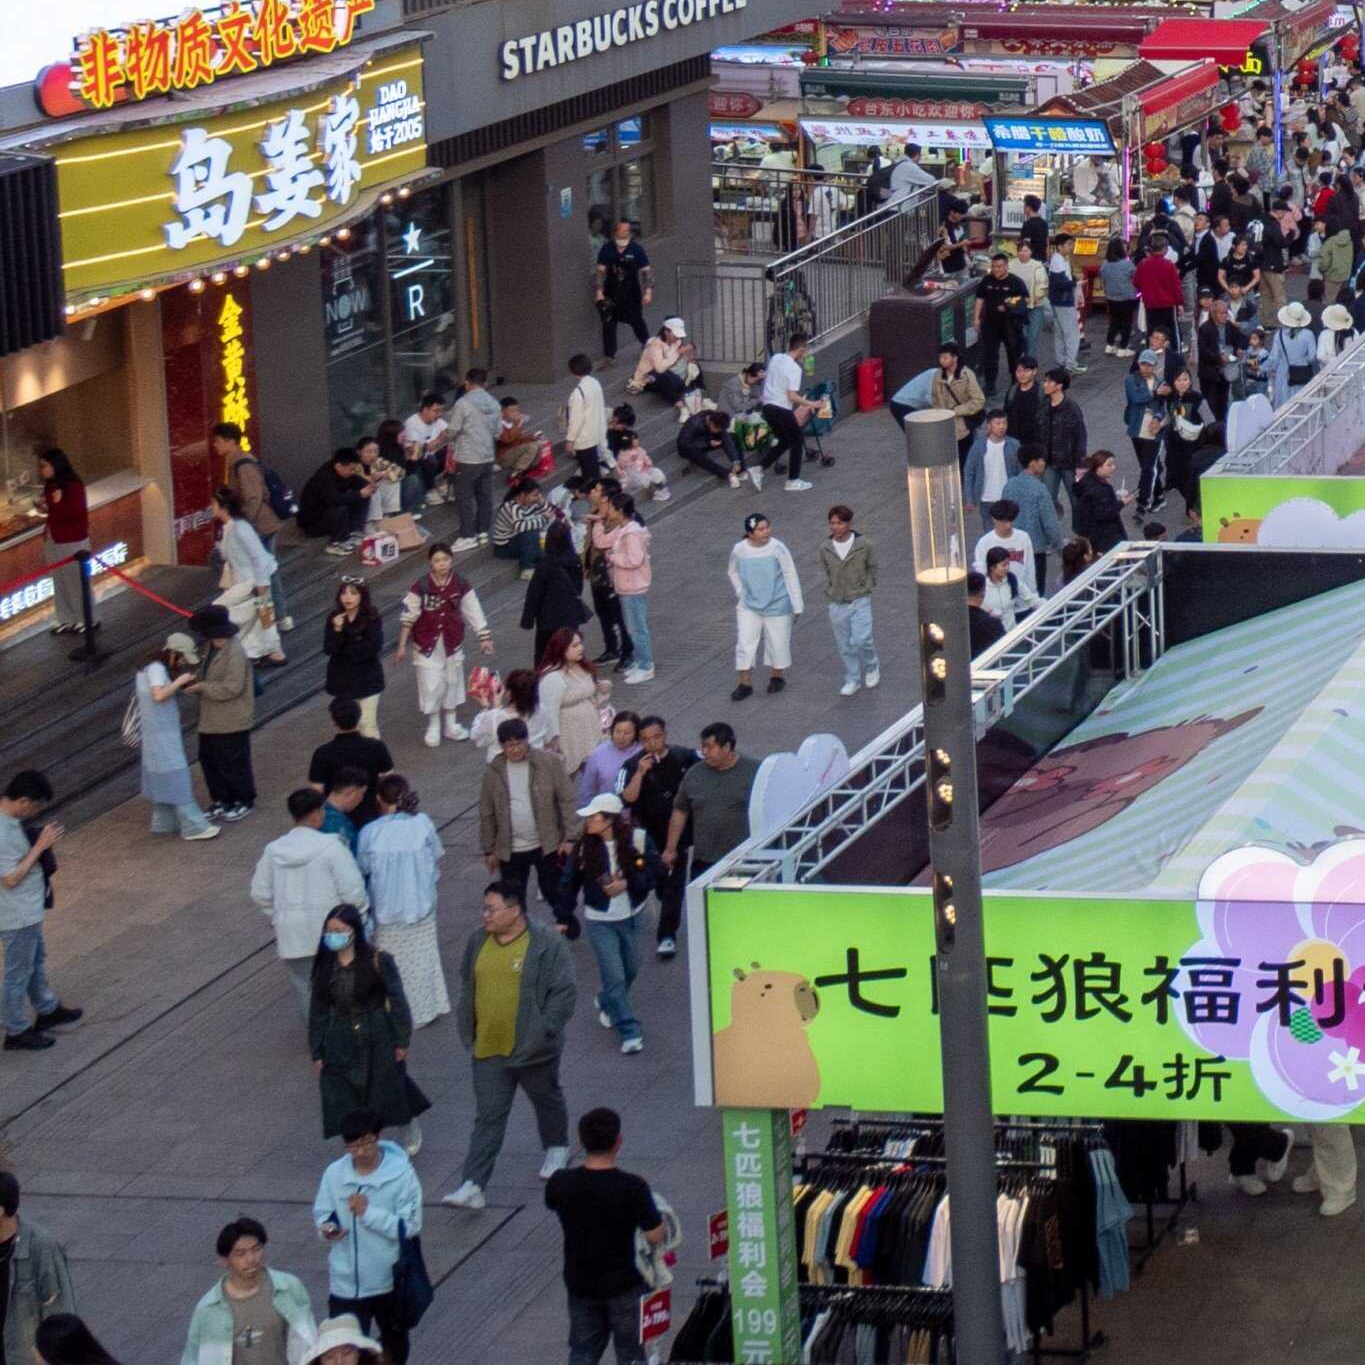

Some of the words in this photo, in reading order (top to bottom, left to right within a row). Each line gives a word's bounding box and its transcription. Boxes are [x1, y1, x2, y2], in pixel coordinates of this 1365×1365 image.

[502, 0, 660, 82] STARBUCKS
[379, 80, 407, 105] DAO
[864, 101, 977, 120] 台东小吃欢迎你
[163, 87, 364, 249] 岛姜家
[408, 284, 426, 321] R
[1016, 1052, 1232, 1103] 2-4折
[735, 1122, 768, 1299] 七匹狼福利会
[737, 1308, 777, 1334] 199
